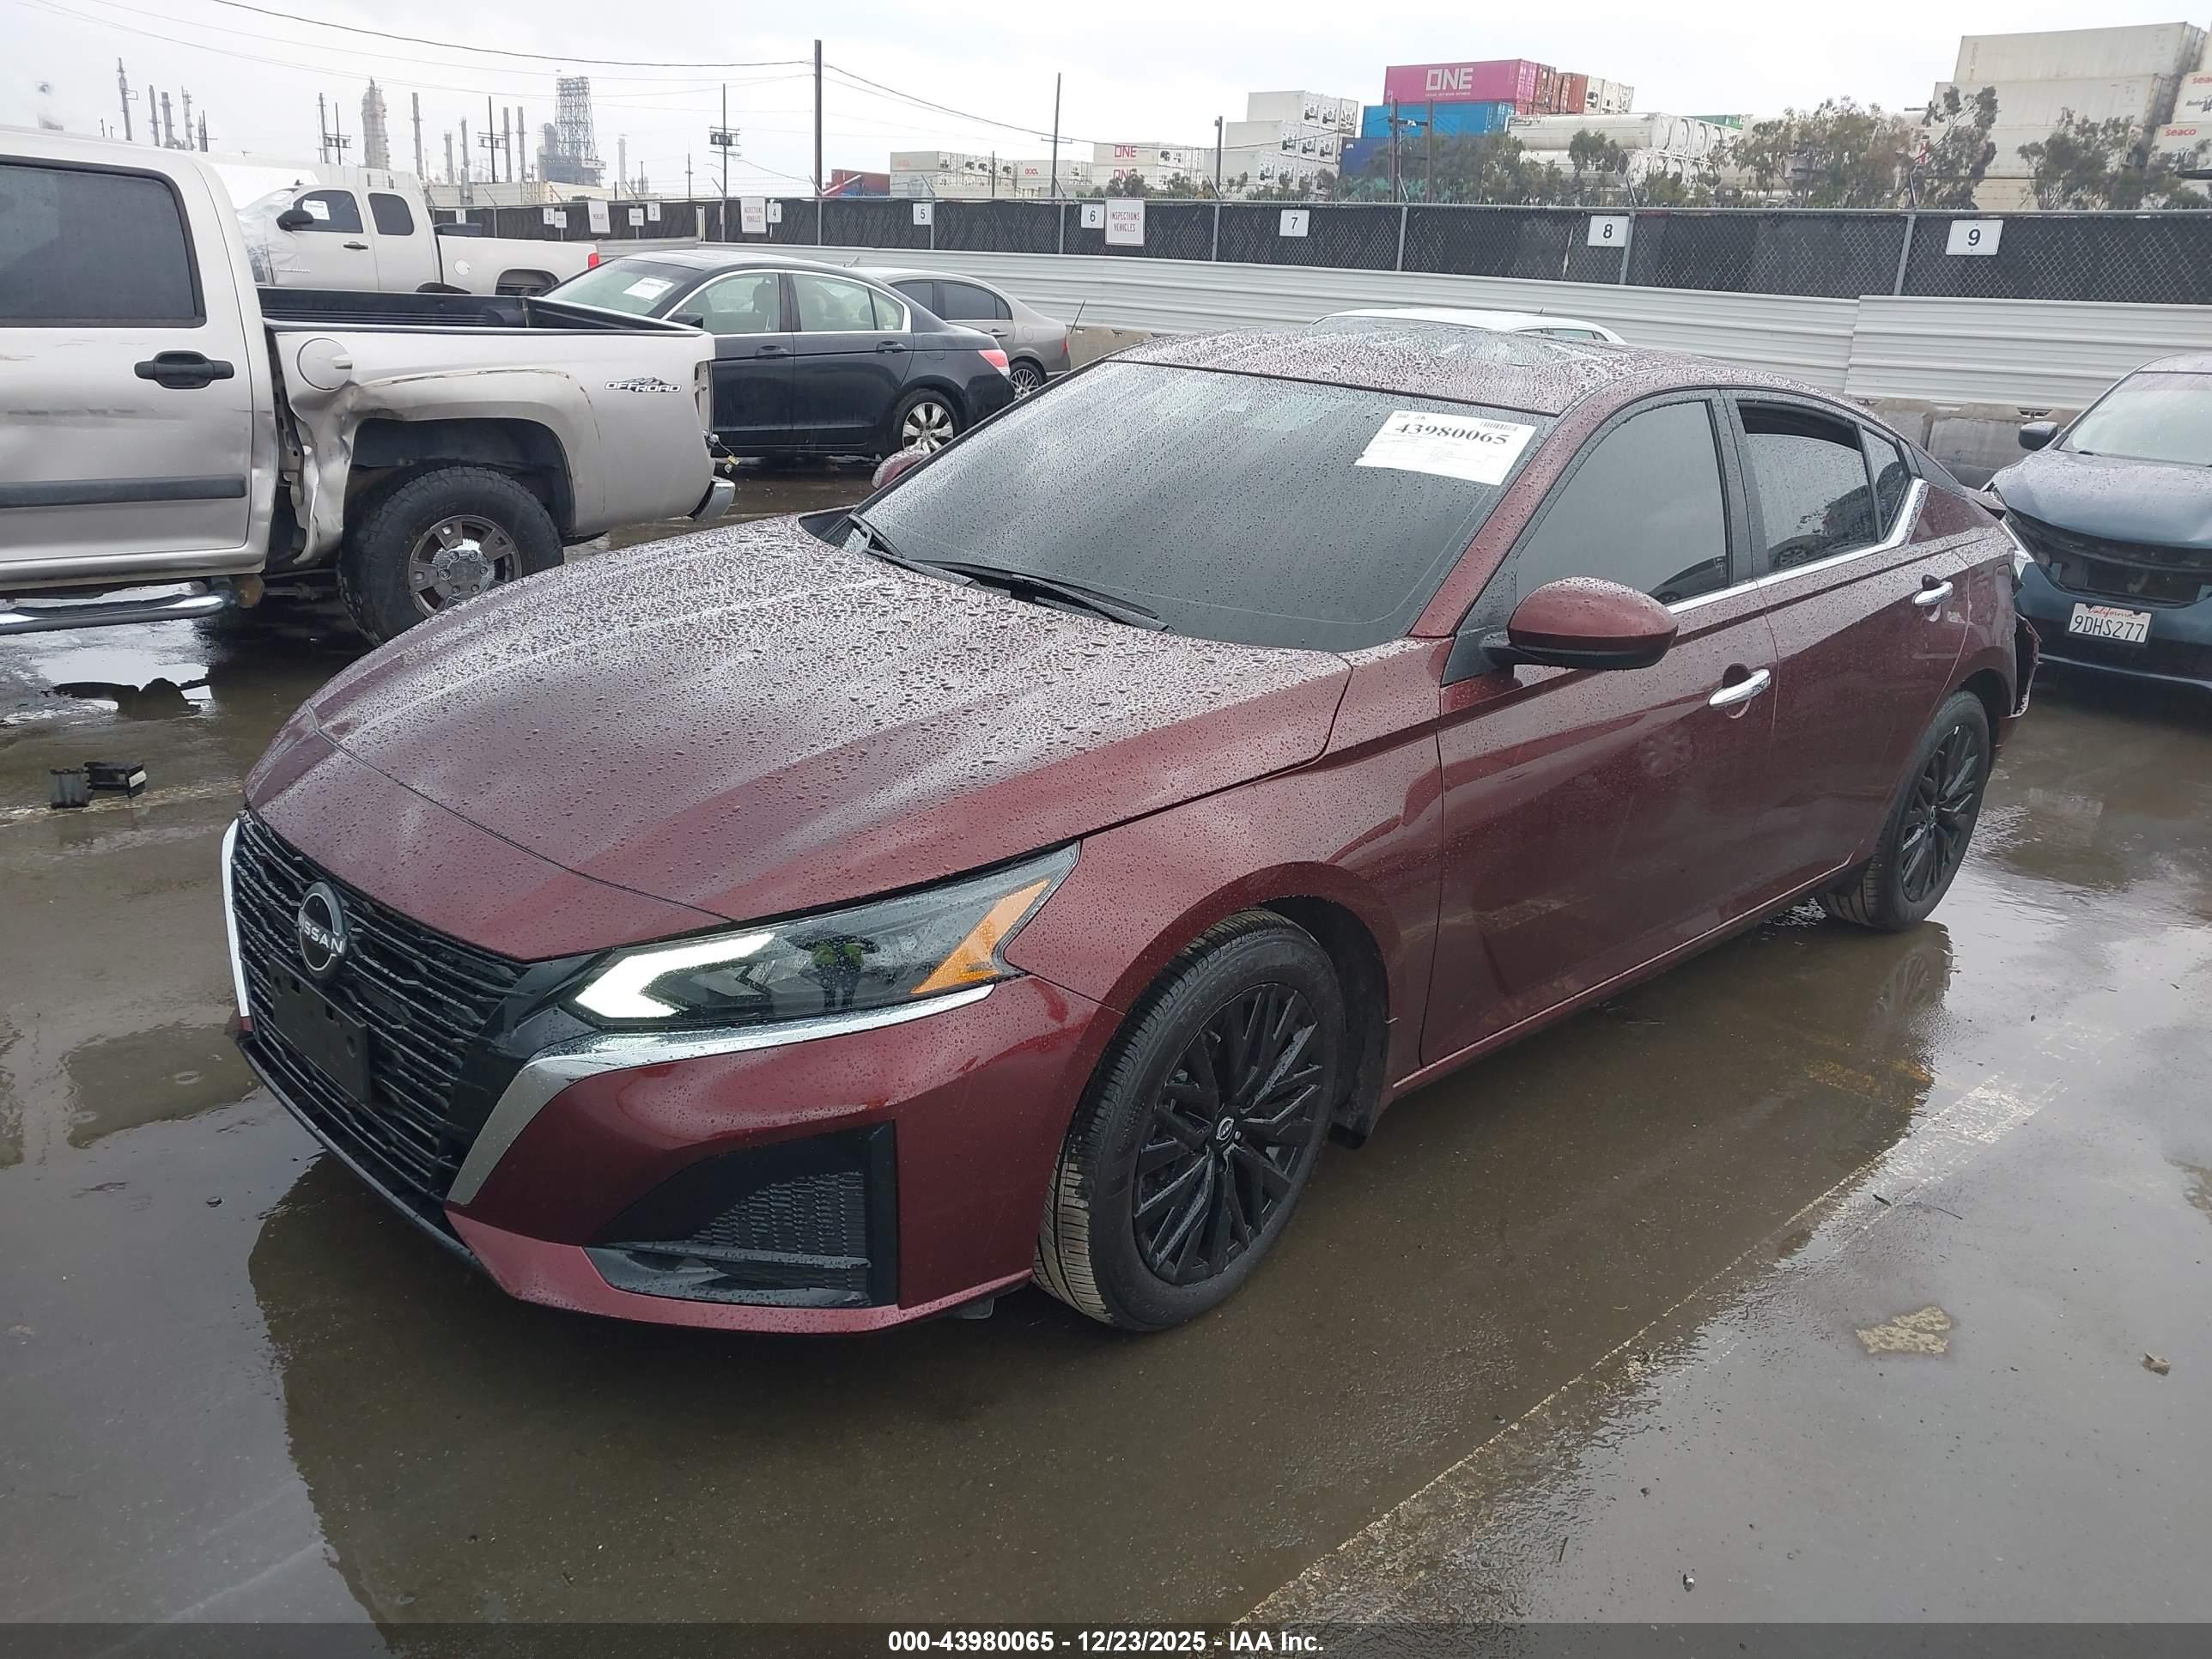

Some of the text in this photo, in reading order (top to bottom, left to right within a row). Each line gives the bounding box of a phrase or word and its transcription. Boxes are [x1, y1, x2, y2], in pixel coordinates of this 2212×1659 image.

[1425, 68, 1474, 90] ONE
[2191, 76, 2212, 84] sea
[1114, 145, 1137, 158] ONE
[772, 207, 777, 218] 4
[920, 208, 926, 219] 5
[1090, 210, 1096, 222] 6
[1109, 211, 1140, 221] INSPECTIONS
[1113, 223, 1136, 232] VEHICLES
[1291, 216, 1298, 229] 7
[1602, 223, 1613, 239] 8
[1967, 228, 1981, 246] 9
[1395, 423, 1510, 445] 43980065
[2087, 607, 2135, 619] California
[2072, 615, 2145, 641] 9DHS277
